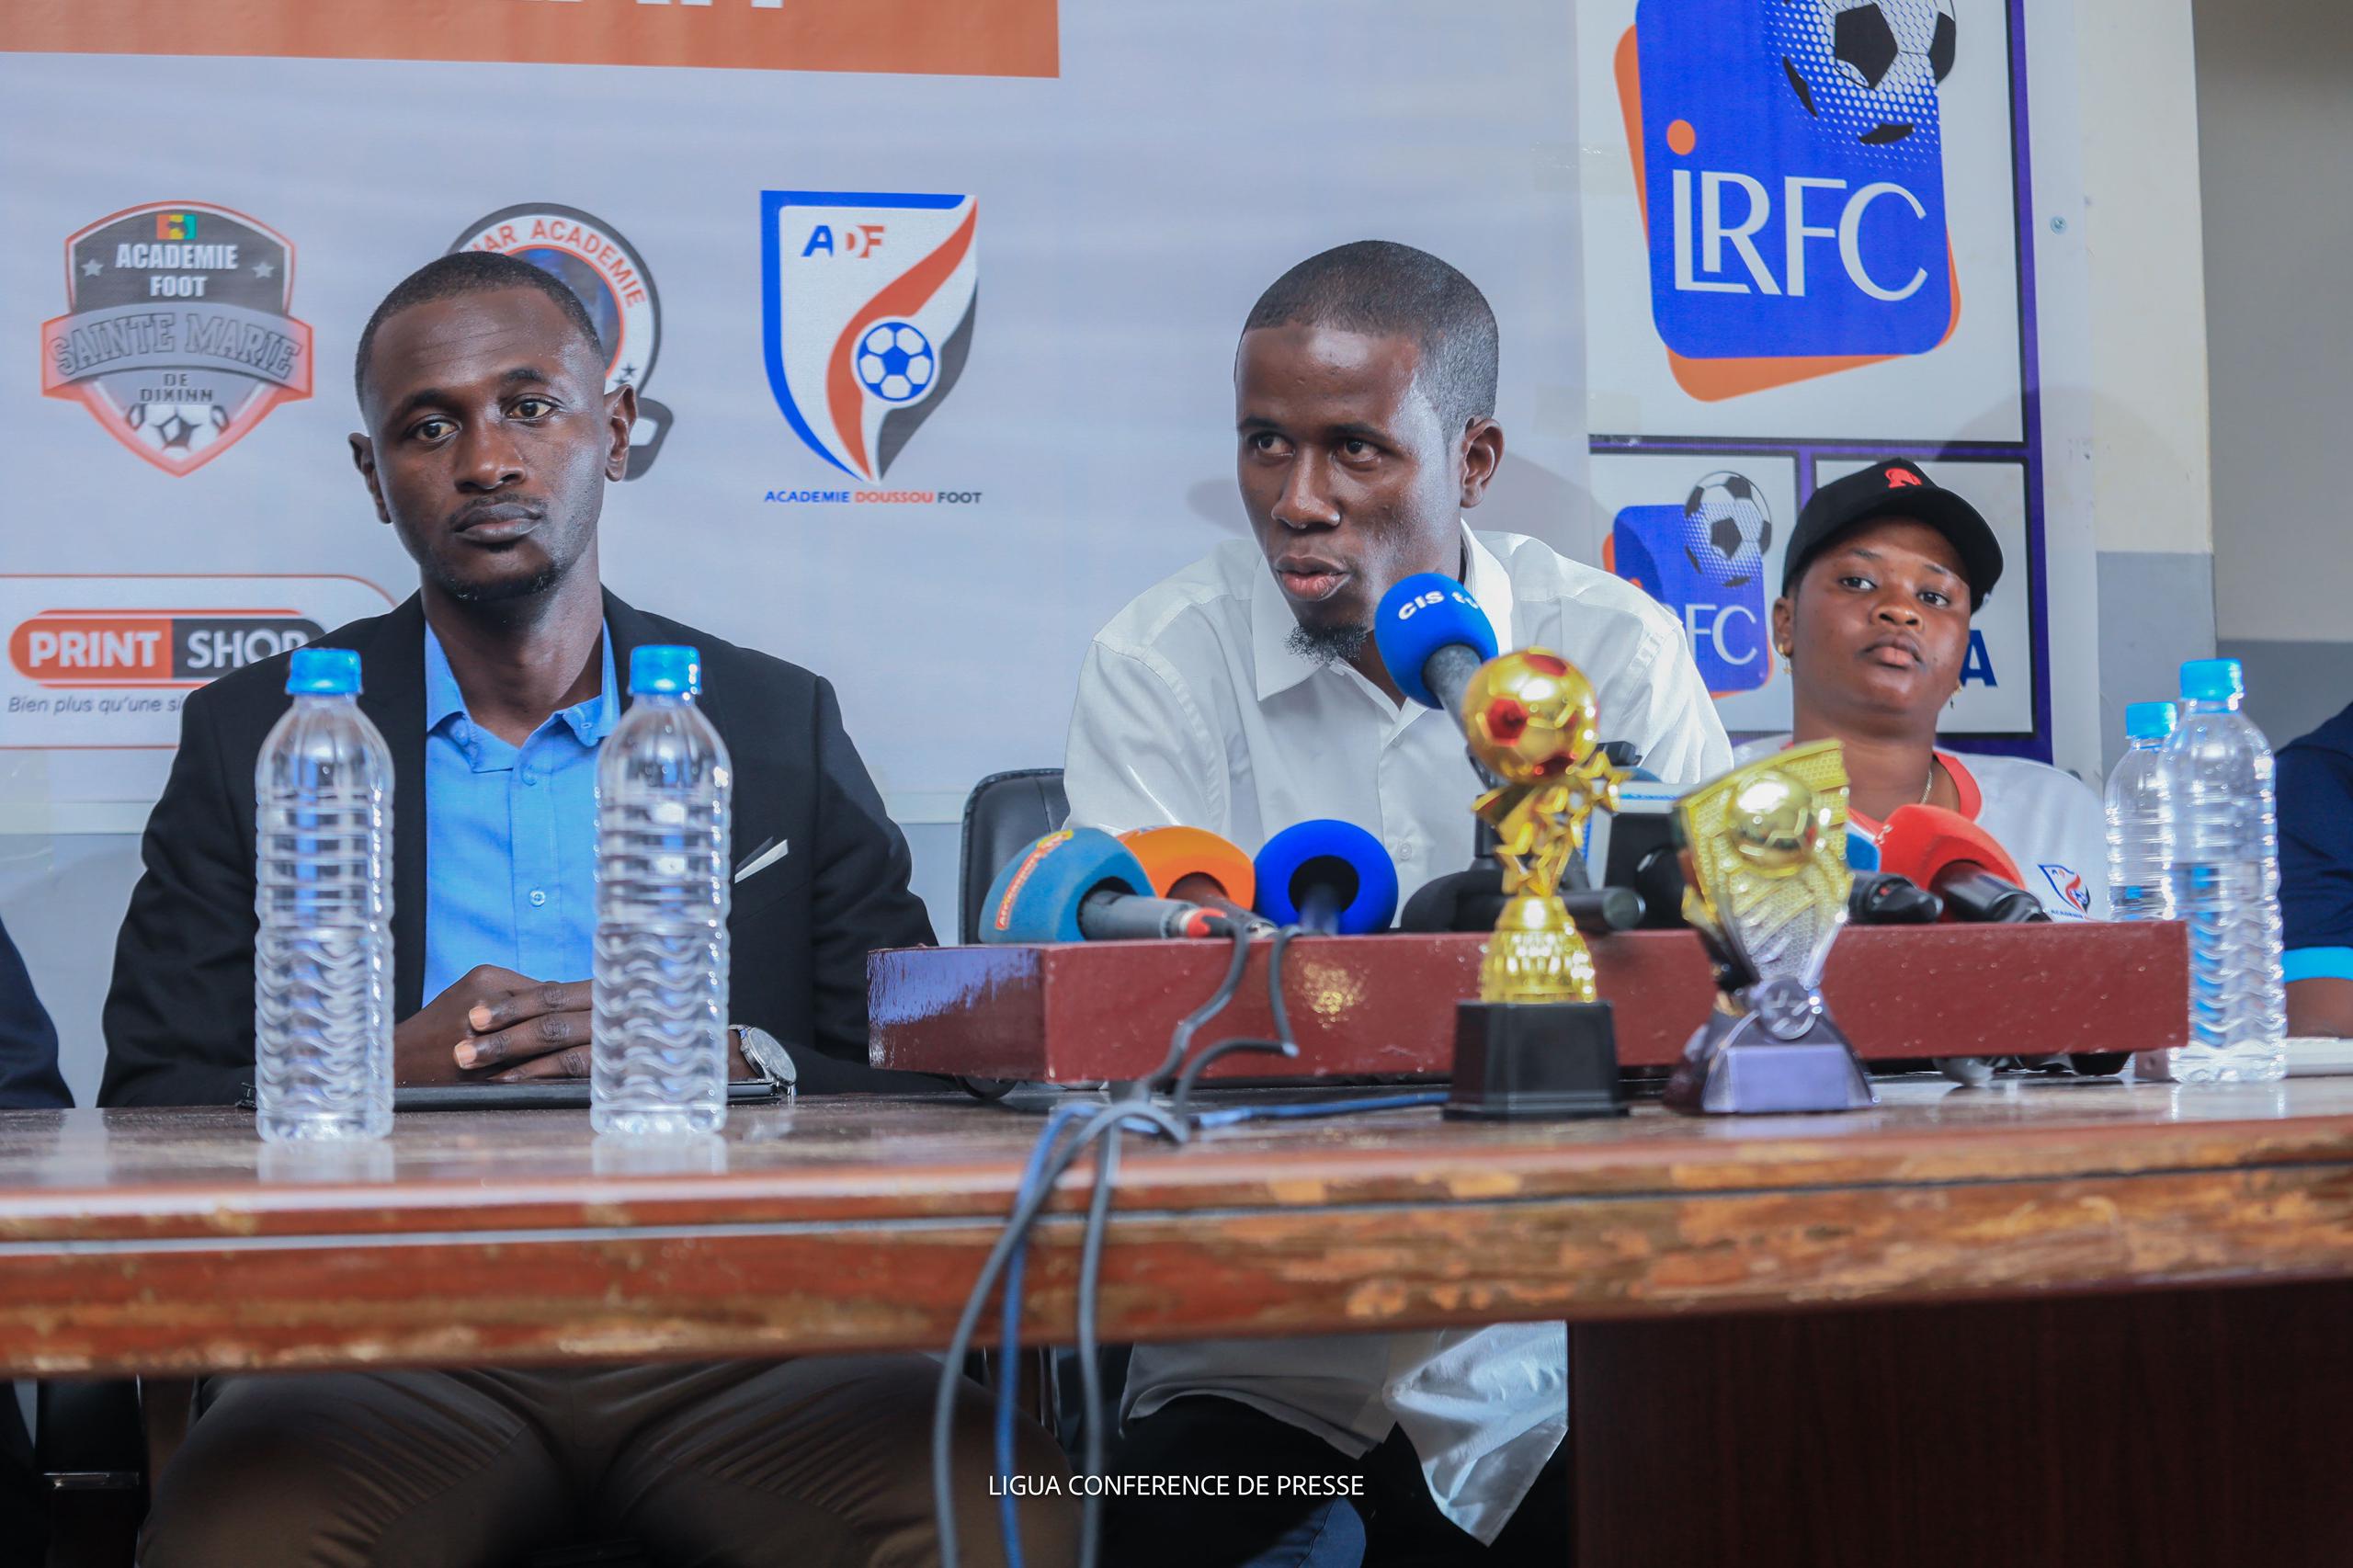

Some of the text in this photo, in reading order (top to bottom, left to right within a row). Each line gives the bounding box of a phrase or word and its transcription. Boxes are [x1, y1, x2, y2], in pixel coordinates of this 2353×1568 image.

[115, 243, 239, 270] ACADEMIE
[530, 220, 648, 308] ACADEMIE
[149, 276, 209, 297] FOOT
[50, 312, 303, 380] SAINTE MARIE
[162, 373, 189, 387] DE
[765, 491, 983, 505] ACADEMIE DOUSSOU FOOT
[28, 628, 310, 669] PRINT SHOP
[8, 696, 49, 713] Bien
[53, 696, 93, 715] plus
